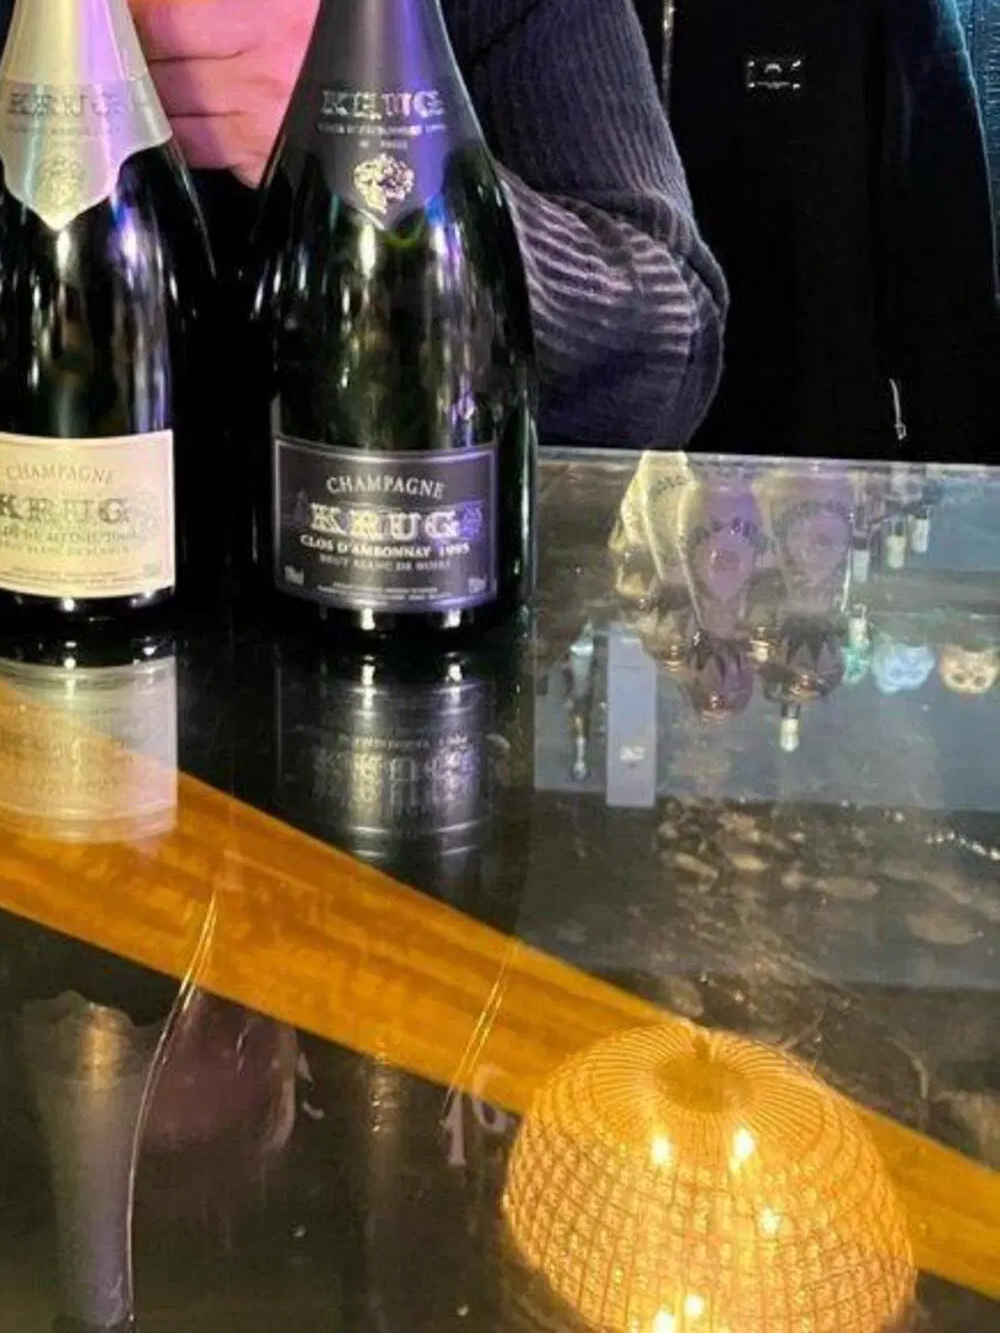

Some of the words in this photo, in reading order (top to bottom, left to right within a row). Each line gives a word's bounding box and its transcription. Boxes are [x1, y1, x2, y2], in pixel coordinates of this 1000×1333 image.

[321, 89, 445, 119] KRUG
[5, 462, 114, 486] CHAMPAGNE
[325, 474, 446, 500] CHAMPAGNE
[310, 502, 461, 541] KRUG
[300, 534, 334, 552] CLOS
